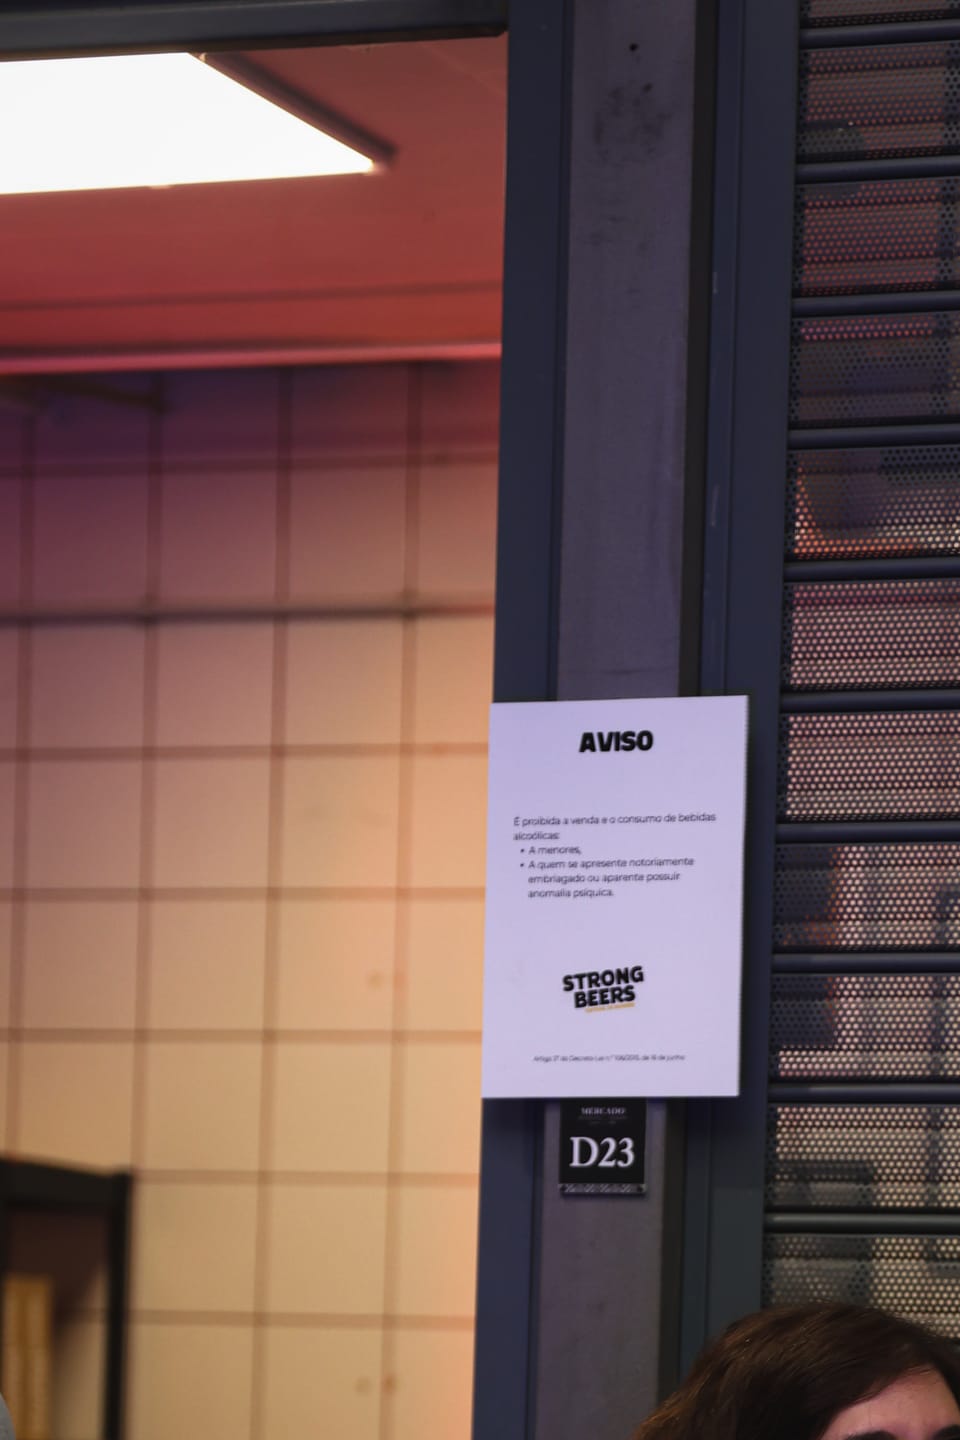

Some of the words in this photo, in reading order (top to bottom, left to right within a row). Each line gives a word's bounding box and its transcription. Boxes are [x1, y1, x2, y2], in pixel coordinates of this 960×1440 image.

[579, 730, 653, 753] AVISO
[513, 816, 520, 826] É
[522, 816, 560, 828] proibida
[570, 816, 599, 825] venda
[617, 816, 662, 824] consumo
[663, 814, 676, 823] de
[678, 813, 716, 823] bebidas
[528, 846, 536, 854] A
[528, 861, 536, 869] A
[538, 862, 566, 871] quem
[580, 860, 627, 870] apresente
[629, 857, 694, 867] notoriamente
[528, 873, 585, 885] embriagado
[602, 873, 644, 884] aparente
[646, 872, 680, 883] possuir
[528, 888, 571, 898] anomalia
[562, 966, 644, 992] STRONG
[574, 985, 635, 1008] BEERS
[569, 1136, 634, 1168] D23
